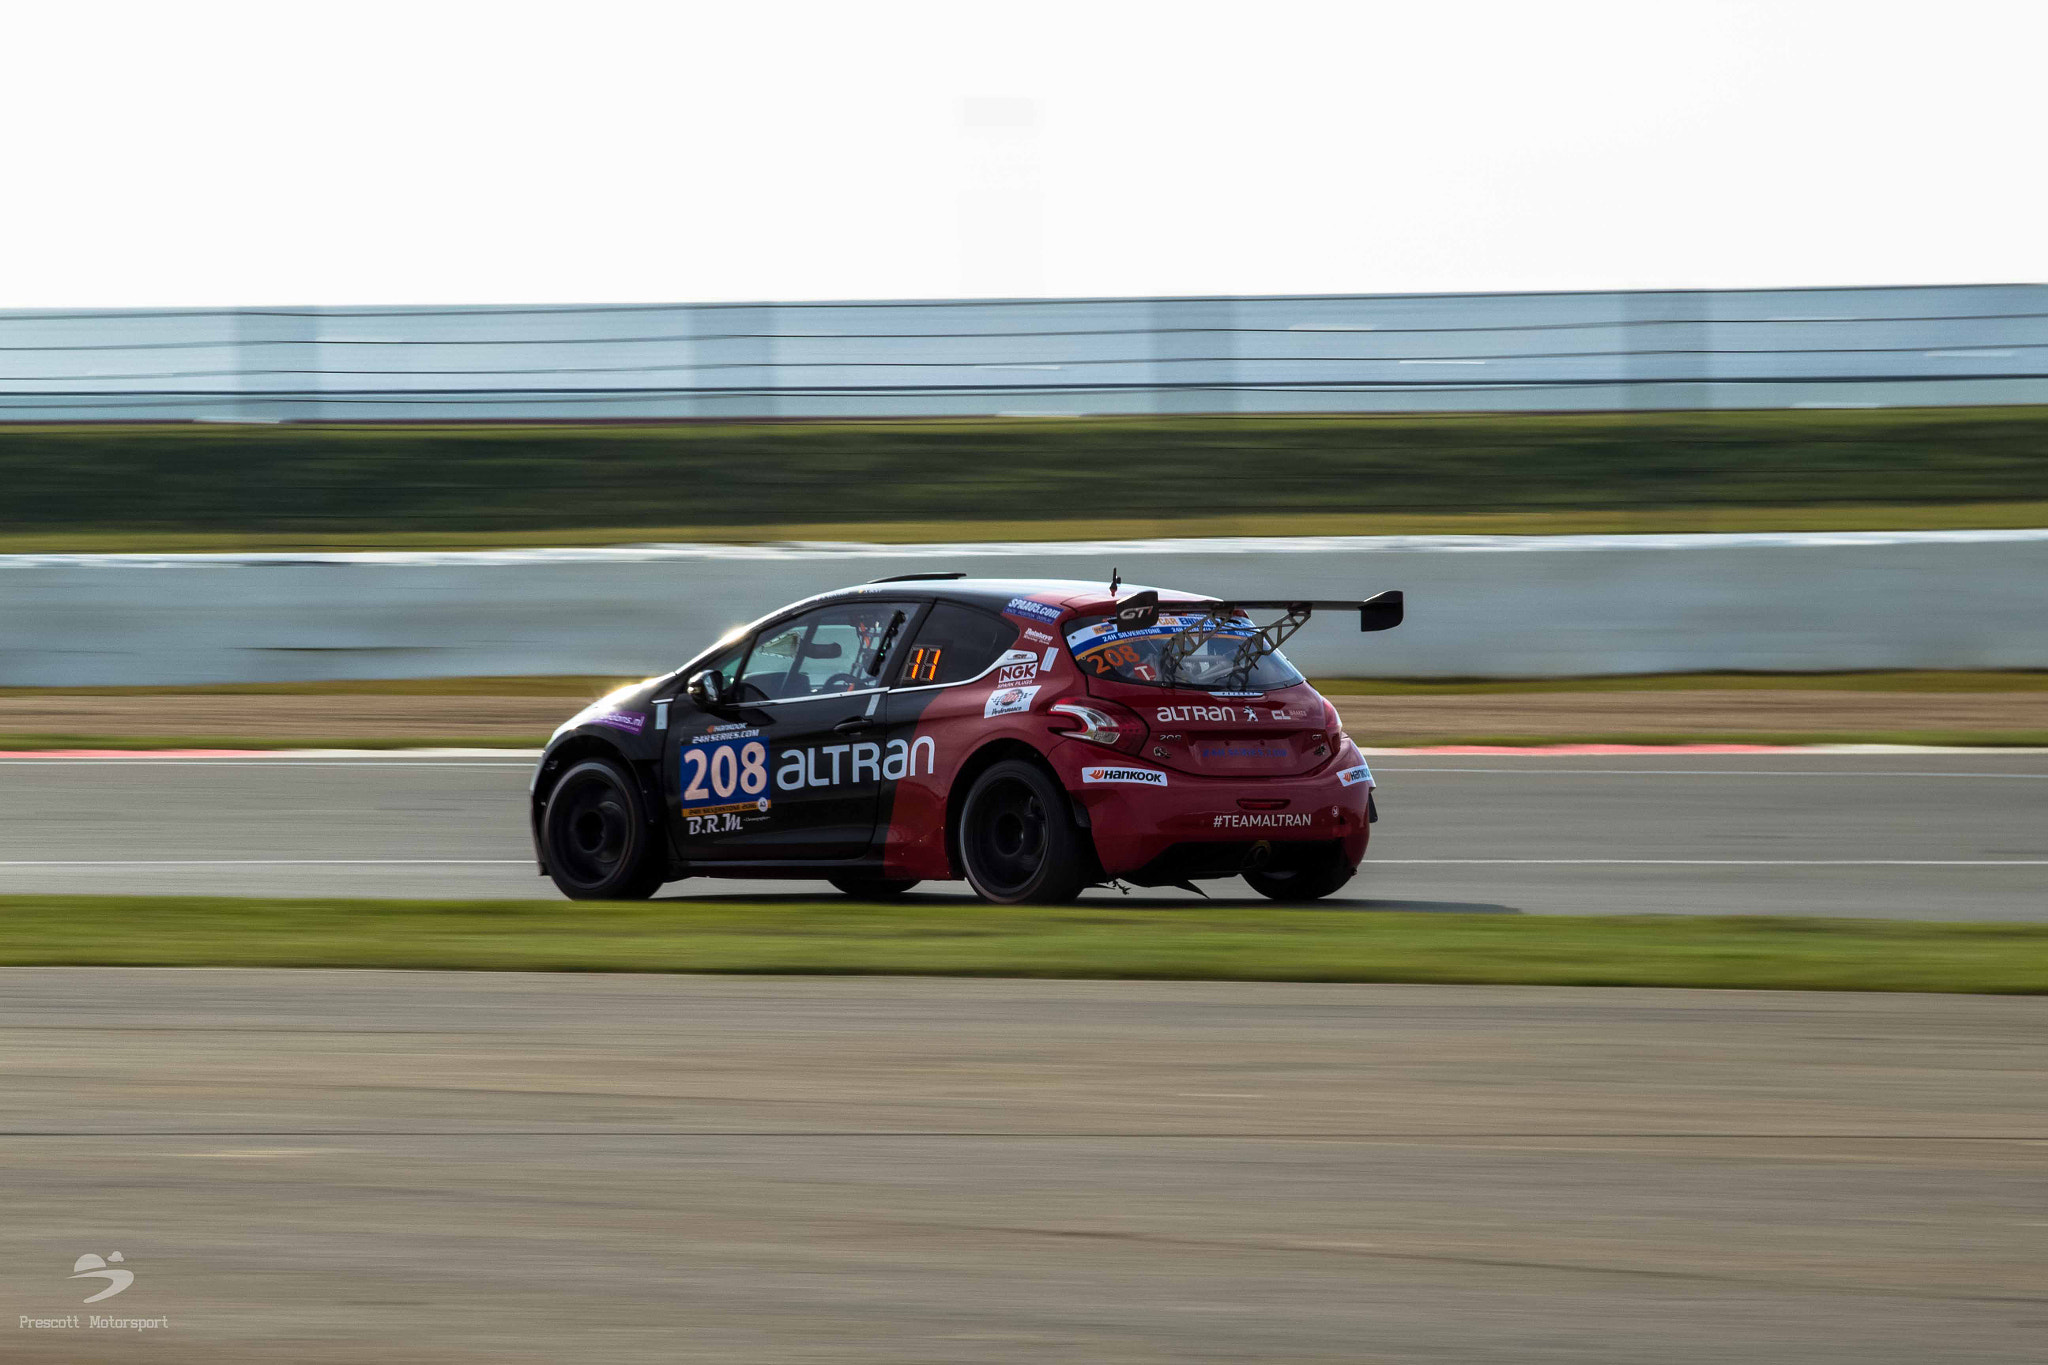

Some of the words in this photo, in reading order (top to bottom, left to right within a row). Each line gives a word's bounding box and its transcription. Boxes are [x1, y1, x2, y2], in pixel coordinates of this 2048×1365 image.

[1102, 633, 1117, 642] 24H
[1117, 628, 1161, 639] SILVERSTONE
[911, 648, 942, 681] 11
[1087, 645, 1139, 674] 208
[1000, 664, 1036, 682] NGK
[684, 741, 767, 800] 208
[1213, 814, 1312, 828] #TEAMALTRAN
